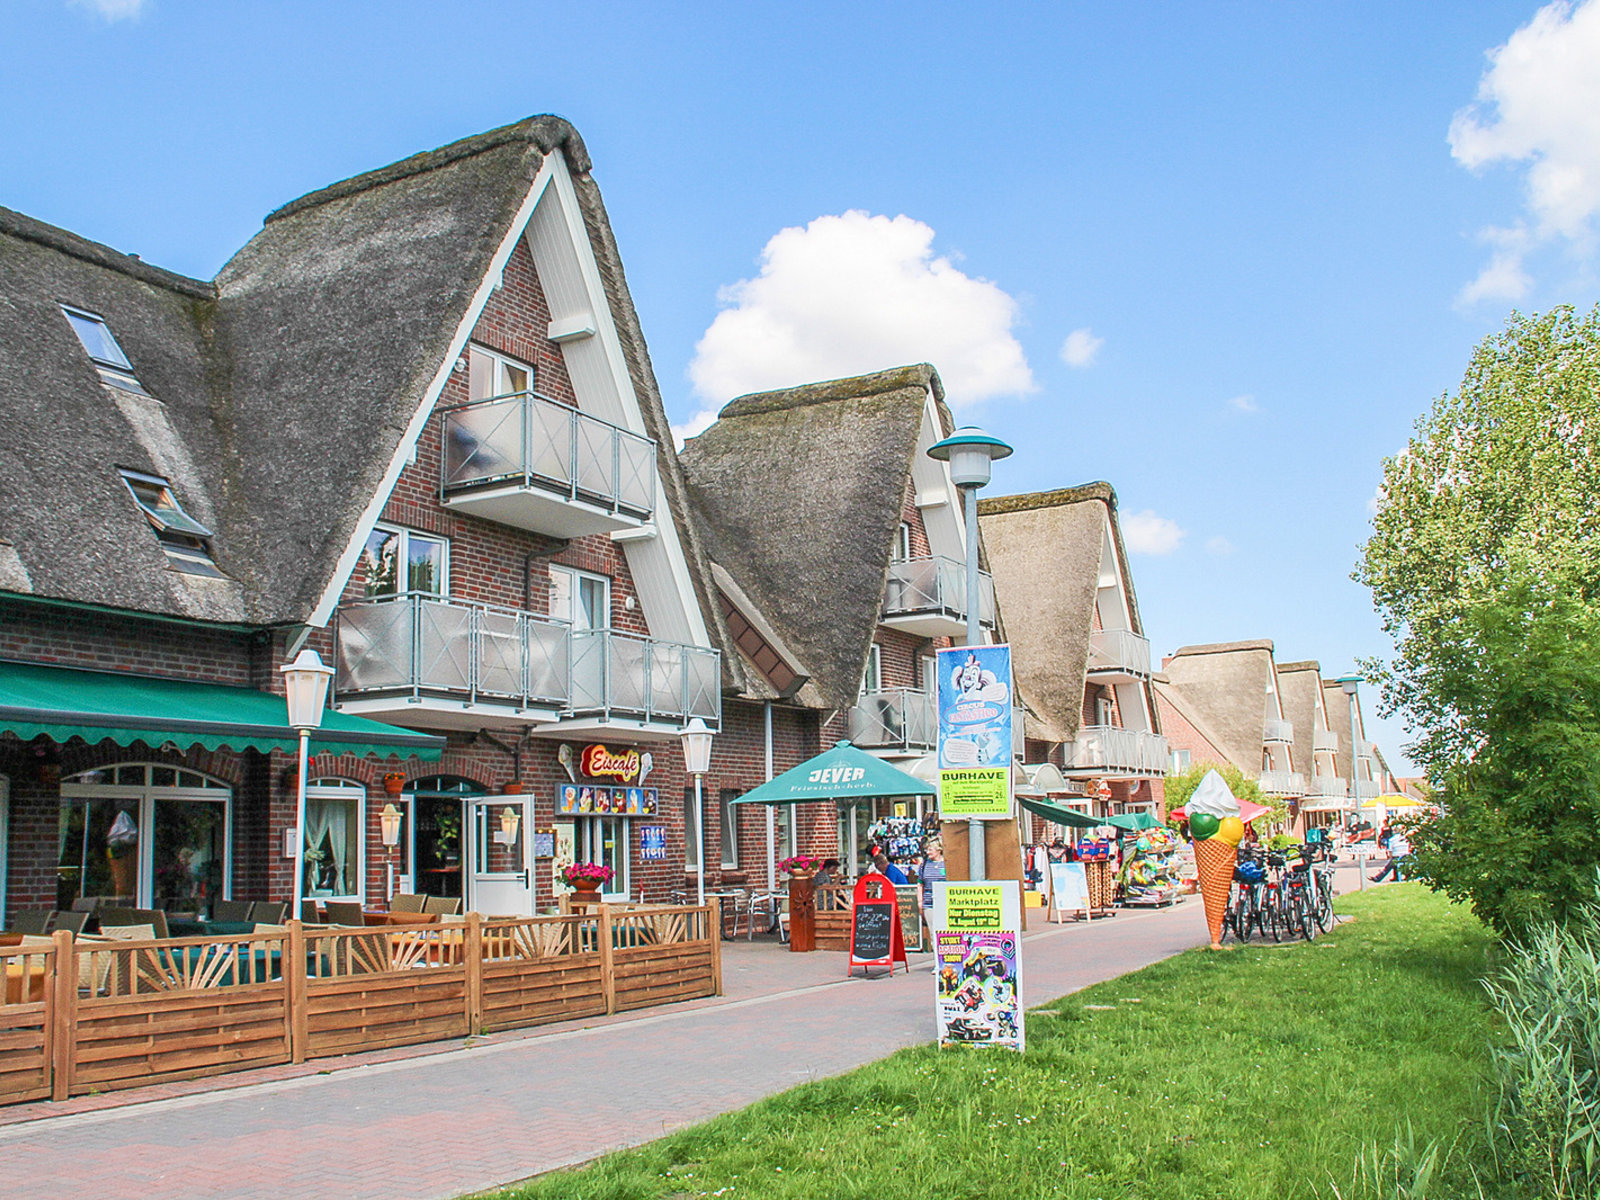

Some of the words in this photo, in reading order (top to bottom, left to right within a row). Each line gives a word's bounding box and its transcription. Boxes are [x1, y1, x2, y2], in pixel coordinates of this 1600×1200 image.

[948, 708, 998, 721] FANTASTICO
[592, 750, 637, 777] Eiscafé
[808, 767, 865, 783] JEVER
[942, 771, 1005, 780] BURHAVE
[949, 888, 999, 896] BURHAVE
[949, 898, 998, 906] Marktplatz
[964, 909, 998, 918] Dienstag
[940, 946, 965, 954] ACTION
